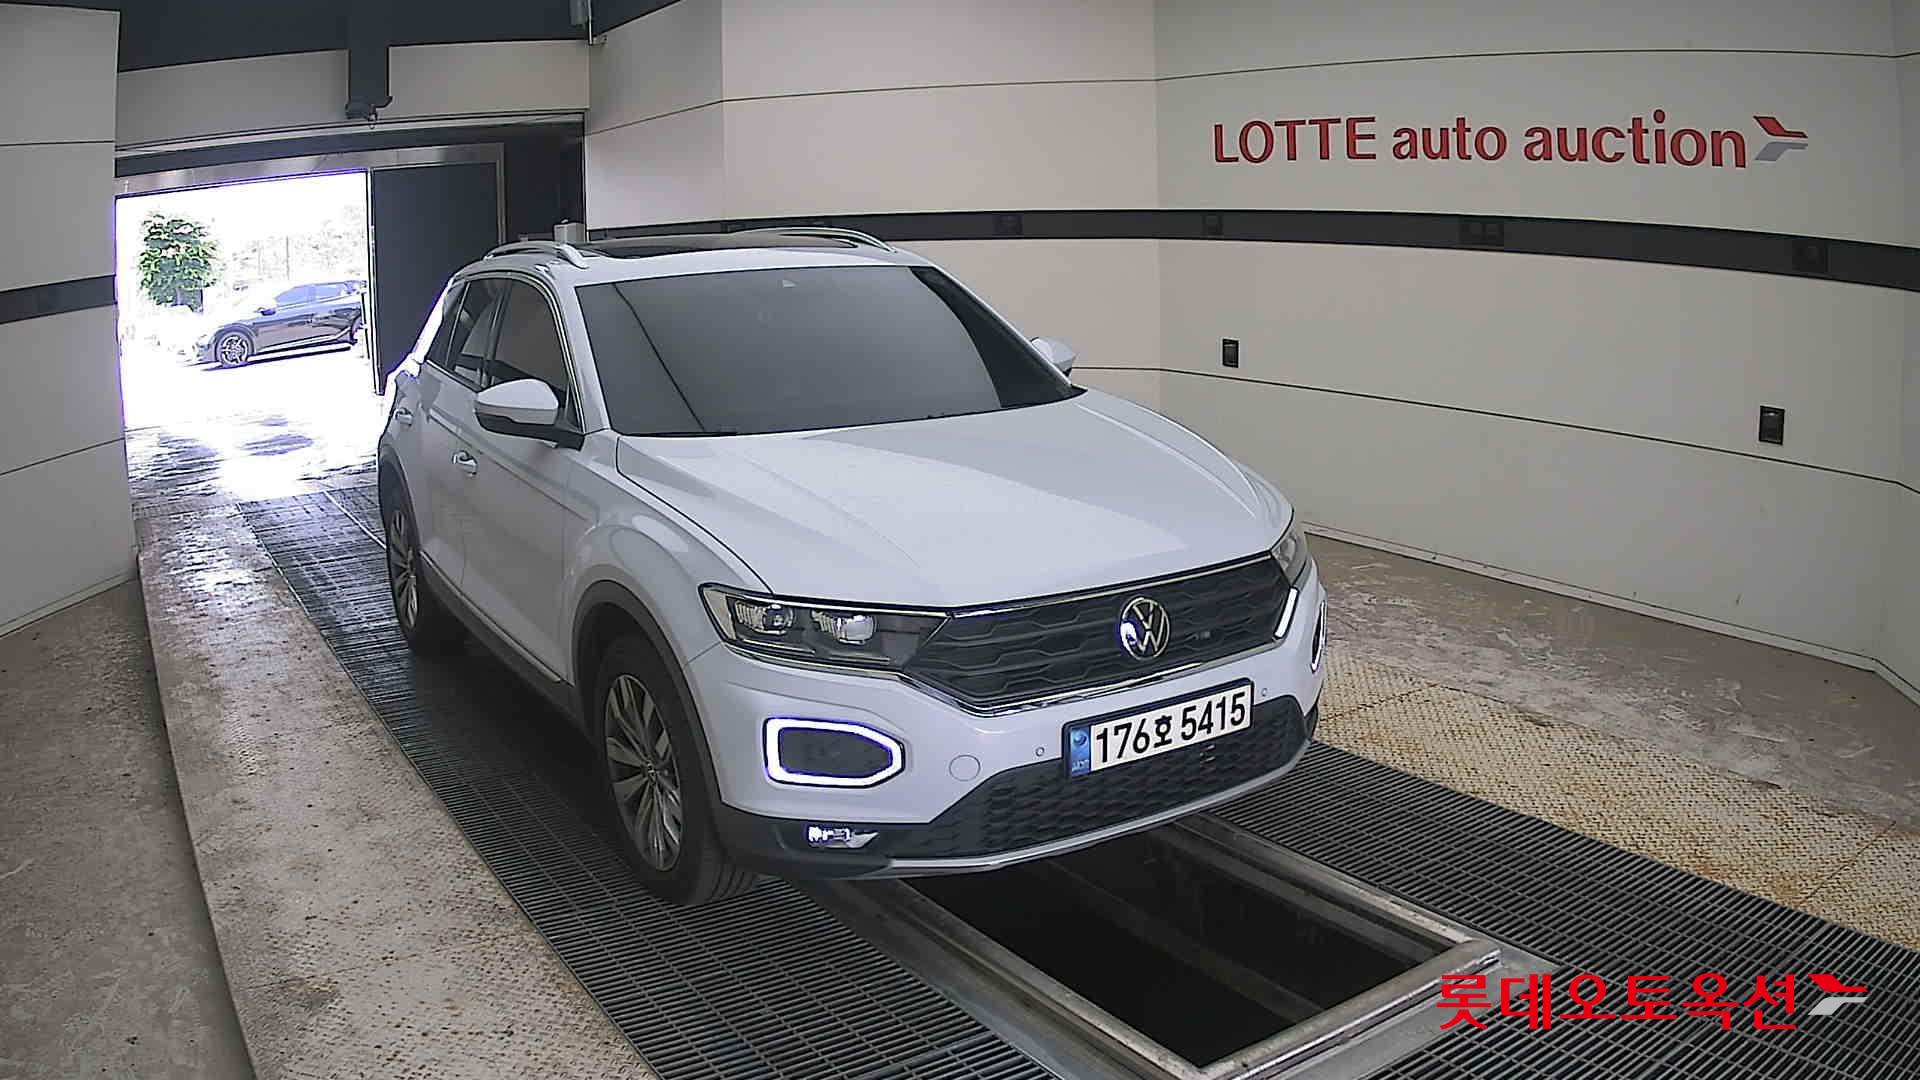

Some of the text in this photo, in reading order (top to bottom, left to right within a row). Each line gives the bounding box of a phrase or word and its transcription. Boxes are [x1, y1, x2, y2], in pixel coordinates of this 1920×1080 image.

[1213, 108, 1747, 169] LOTTE auto auction
[1096, 691, 1246, 763] 176호 5415
